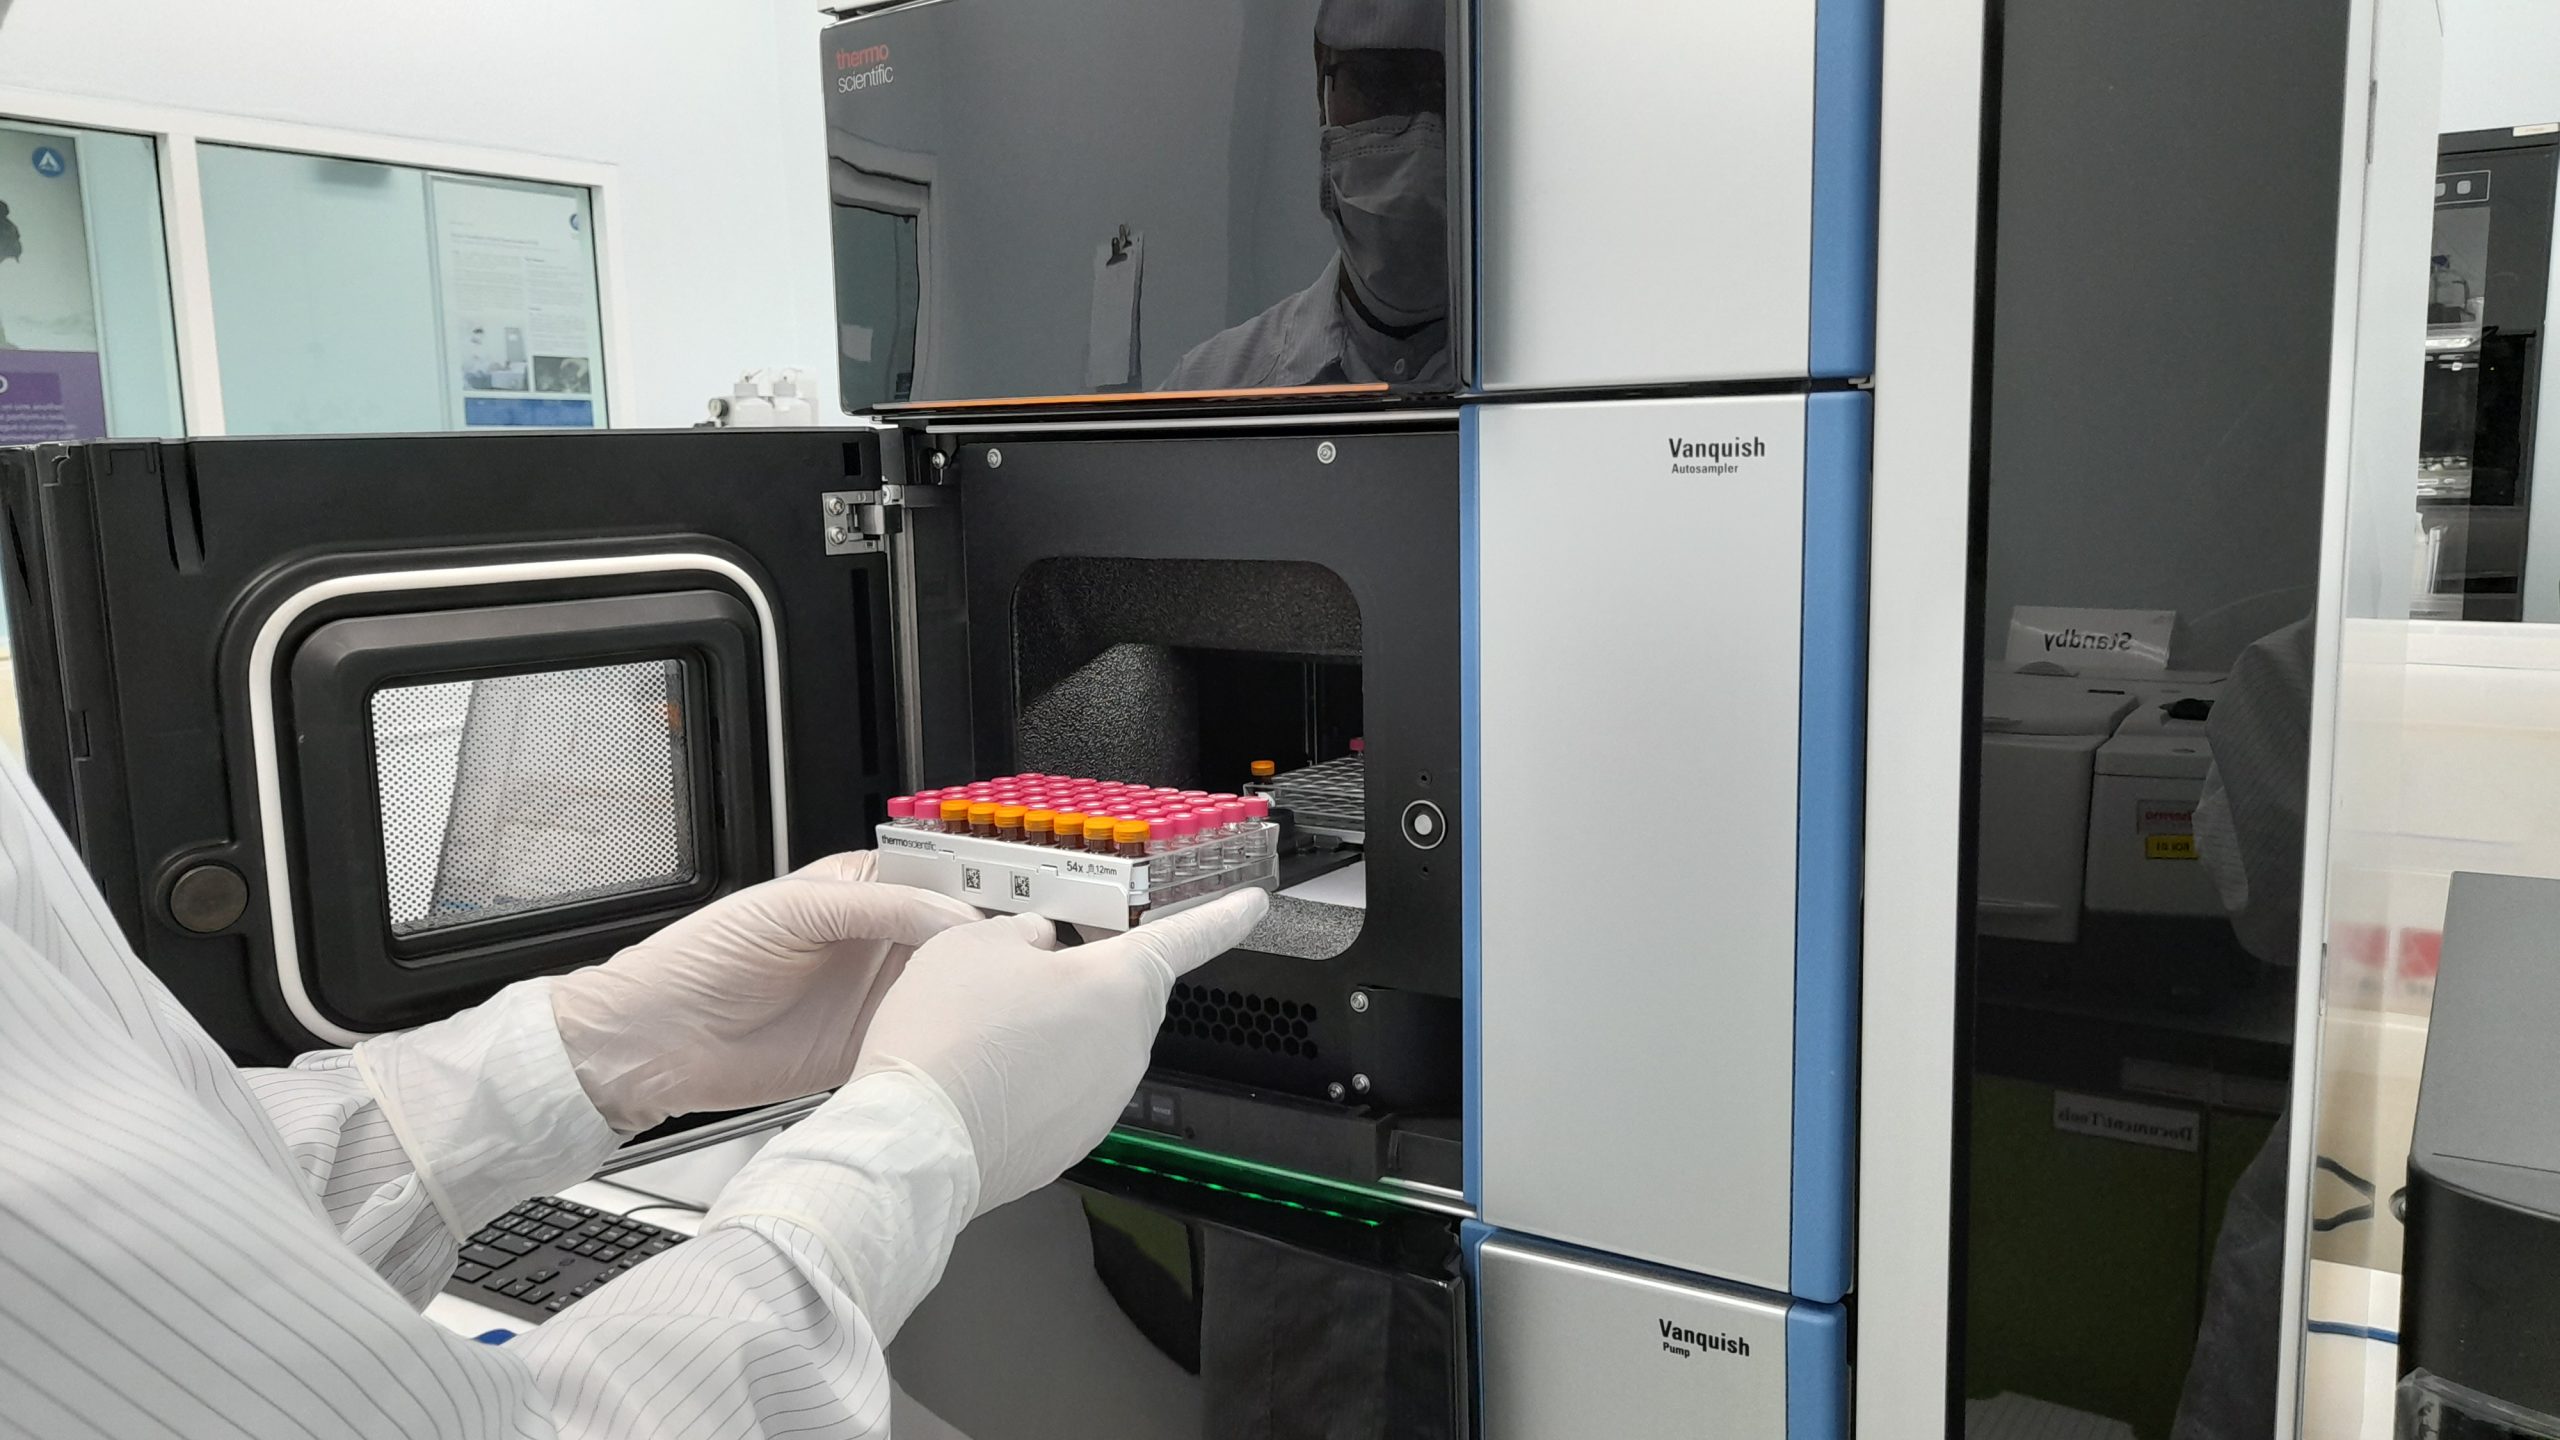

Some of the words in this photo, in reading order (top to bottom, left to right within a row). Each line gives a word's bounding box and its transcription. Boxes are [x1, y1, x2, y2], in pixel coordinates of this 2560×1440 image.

[836, 44, 889, 69] thermo
[838, 63, 894, 93] scientific
[1668, 436, 1765, 463] Vanquish
[1671, 463, 1739, 476] Autosampler
[1066, 860, 1084, 873] 54x
[1095, 864, 1118, 876] 12mm
[1659, 1318, 1750, 1357] Vanquish
[1663, 1341, 1690, 1358] Pump
